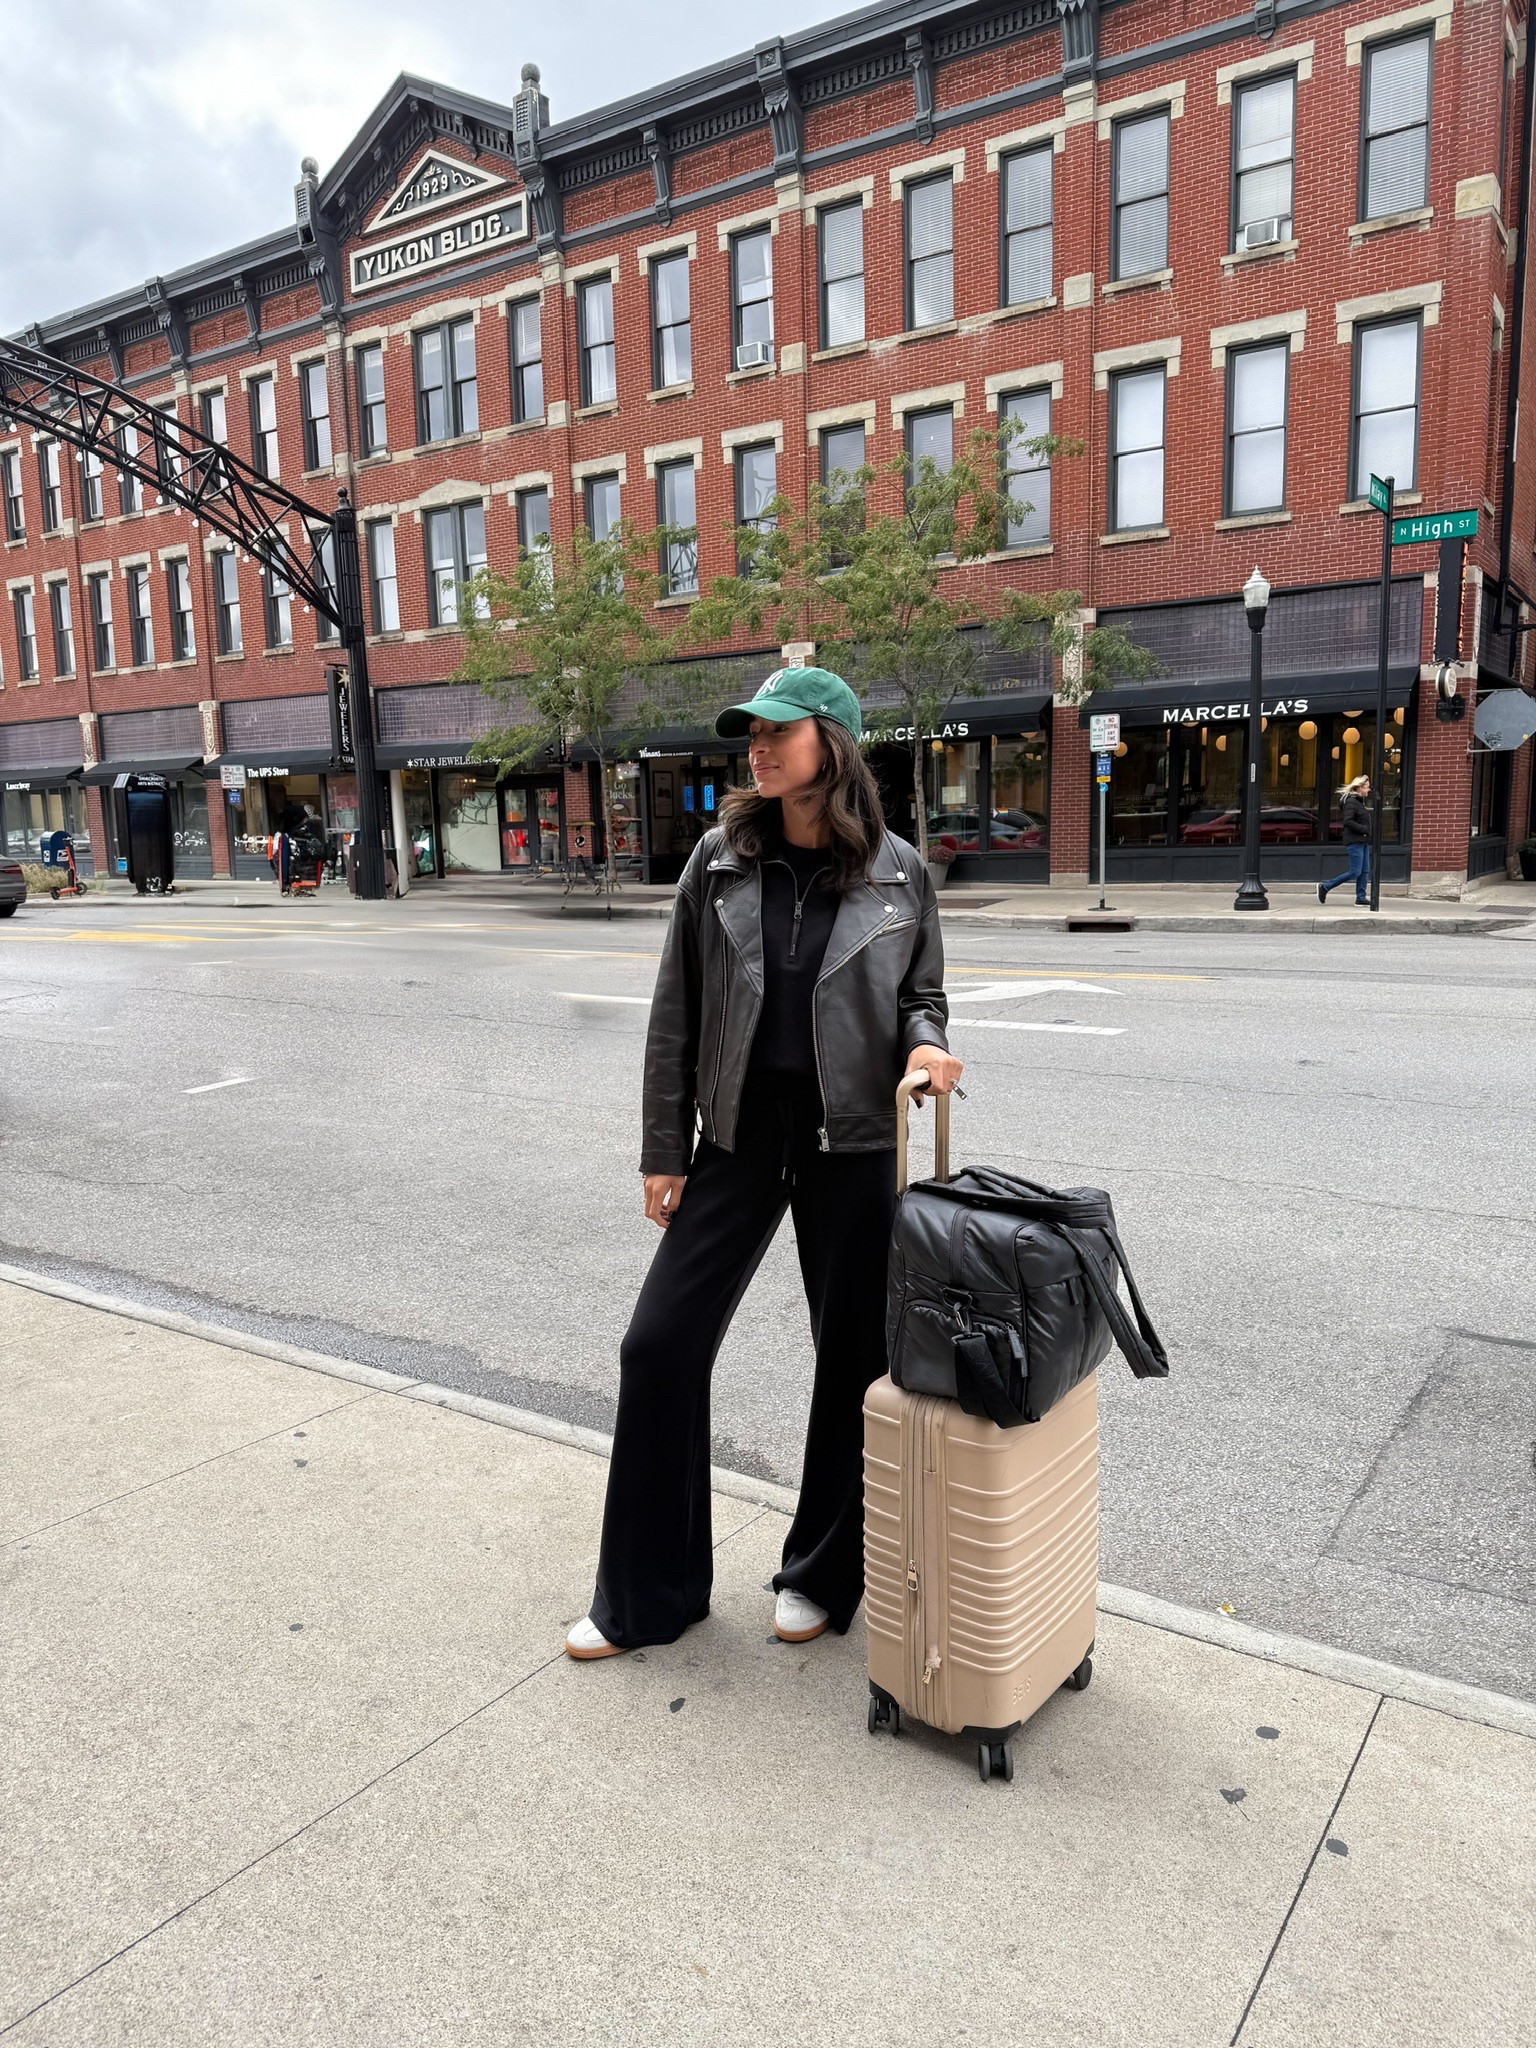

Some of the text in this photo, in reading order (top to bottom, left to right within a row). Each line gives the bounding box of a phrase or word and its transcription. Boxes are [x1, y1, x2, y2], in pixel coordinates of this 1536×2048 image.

[416, 173, 449, 200] 1929
[361, 213, 512, 281] YUKON BLDG.
[1400, 519, 1471, 539] N High ST
[338, 687, 349, 752] JEWELERS
[1162, 699, 1309, 723] MARCELLA'S
[247, 768, 259, 778] The
[259, 767, 272, 778] UPS
[272, 766, 289, 777] Store
[413, 757, 437, 768] STAR
[613, 781, 627, 791] Go
